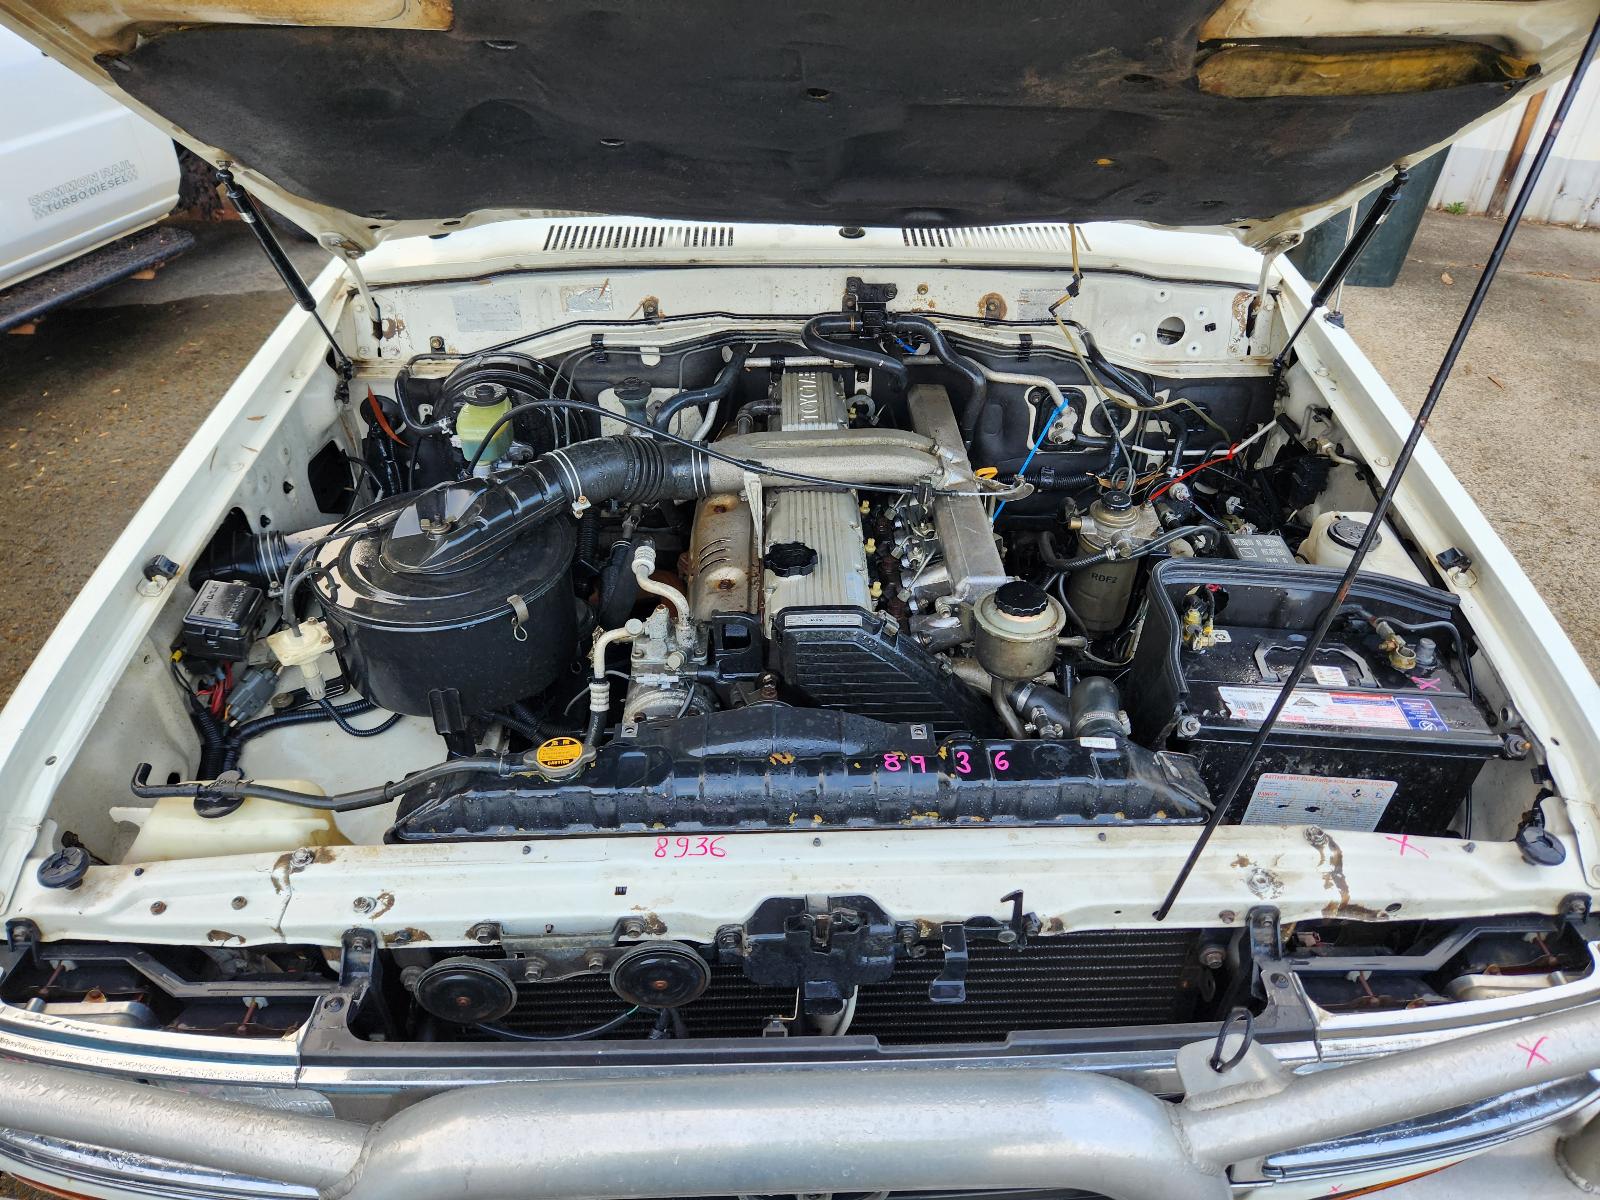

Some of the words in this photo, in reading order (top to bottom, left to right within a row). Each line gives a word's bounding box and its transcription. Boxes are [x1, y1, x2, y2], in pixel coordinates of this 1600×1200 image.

[28, 171, 100, 207] COMMON
[100, 159, 136, 178] RAIL
[47, 189, 88, 212] TURBO
[88, 174, 128, 196] DIESEL
[654, 836, 726, 858] 8936
